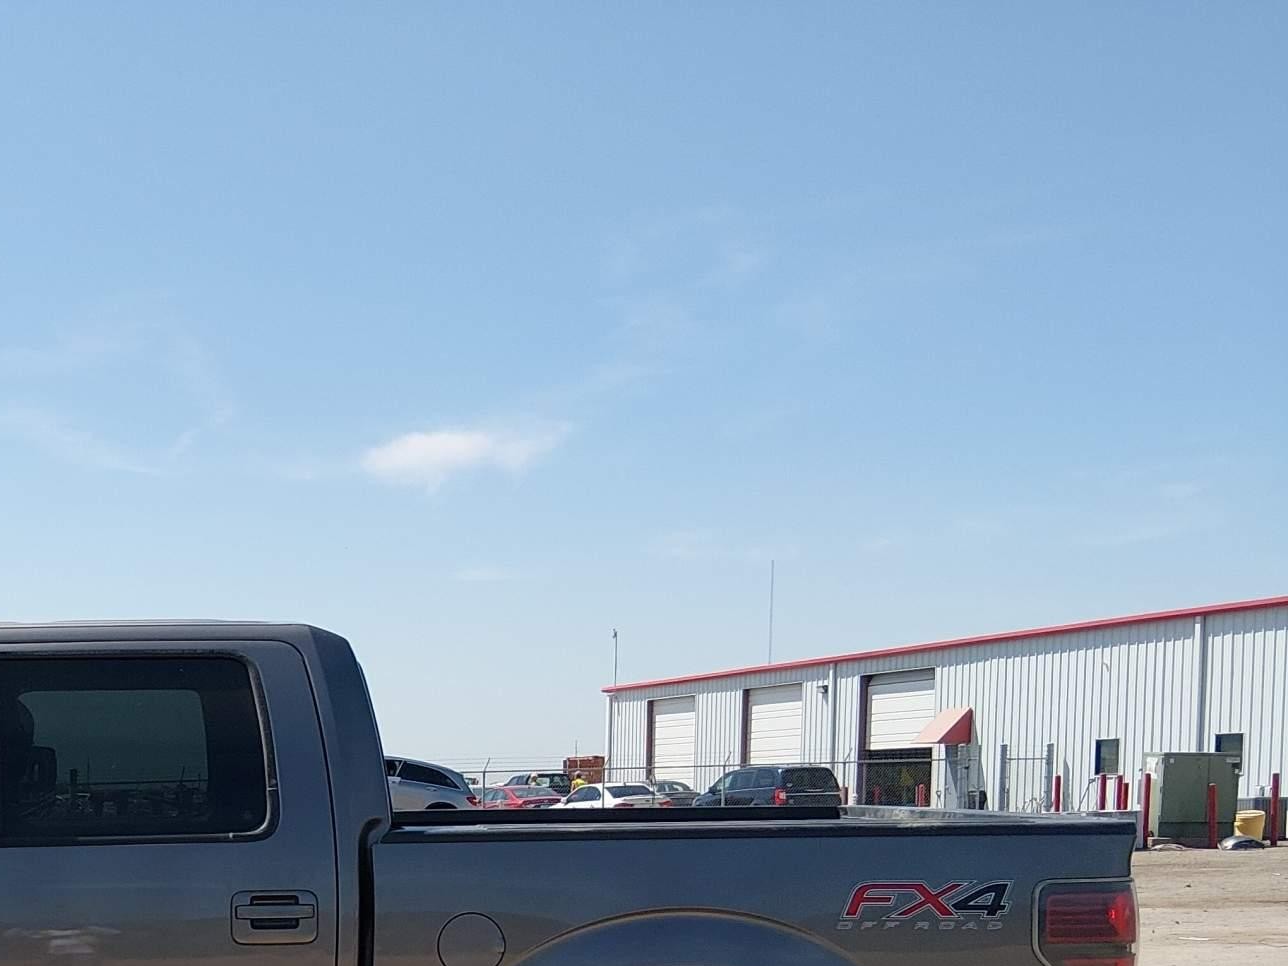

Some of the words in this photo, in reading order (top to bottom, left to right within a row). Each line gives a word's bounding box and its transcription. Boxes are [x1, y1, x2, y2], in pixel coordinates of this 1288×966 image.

[840, 880, 1014, 919] FX4
[836, 921, 902, 930] OFF
[914, 921, 1004, 930] ROAD
